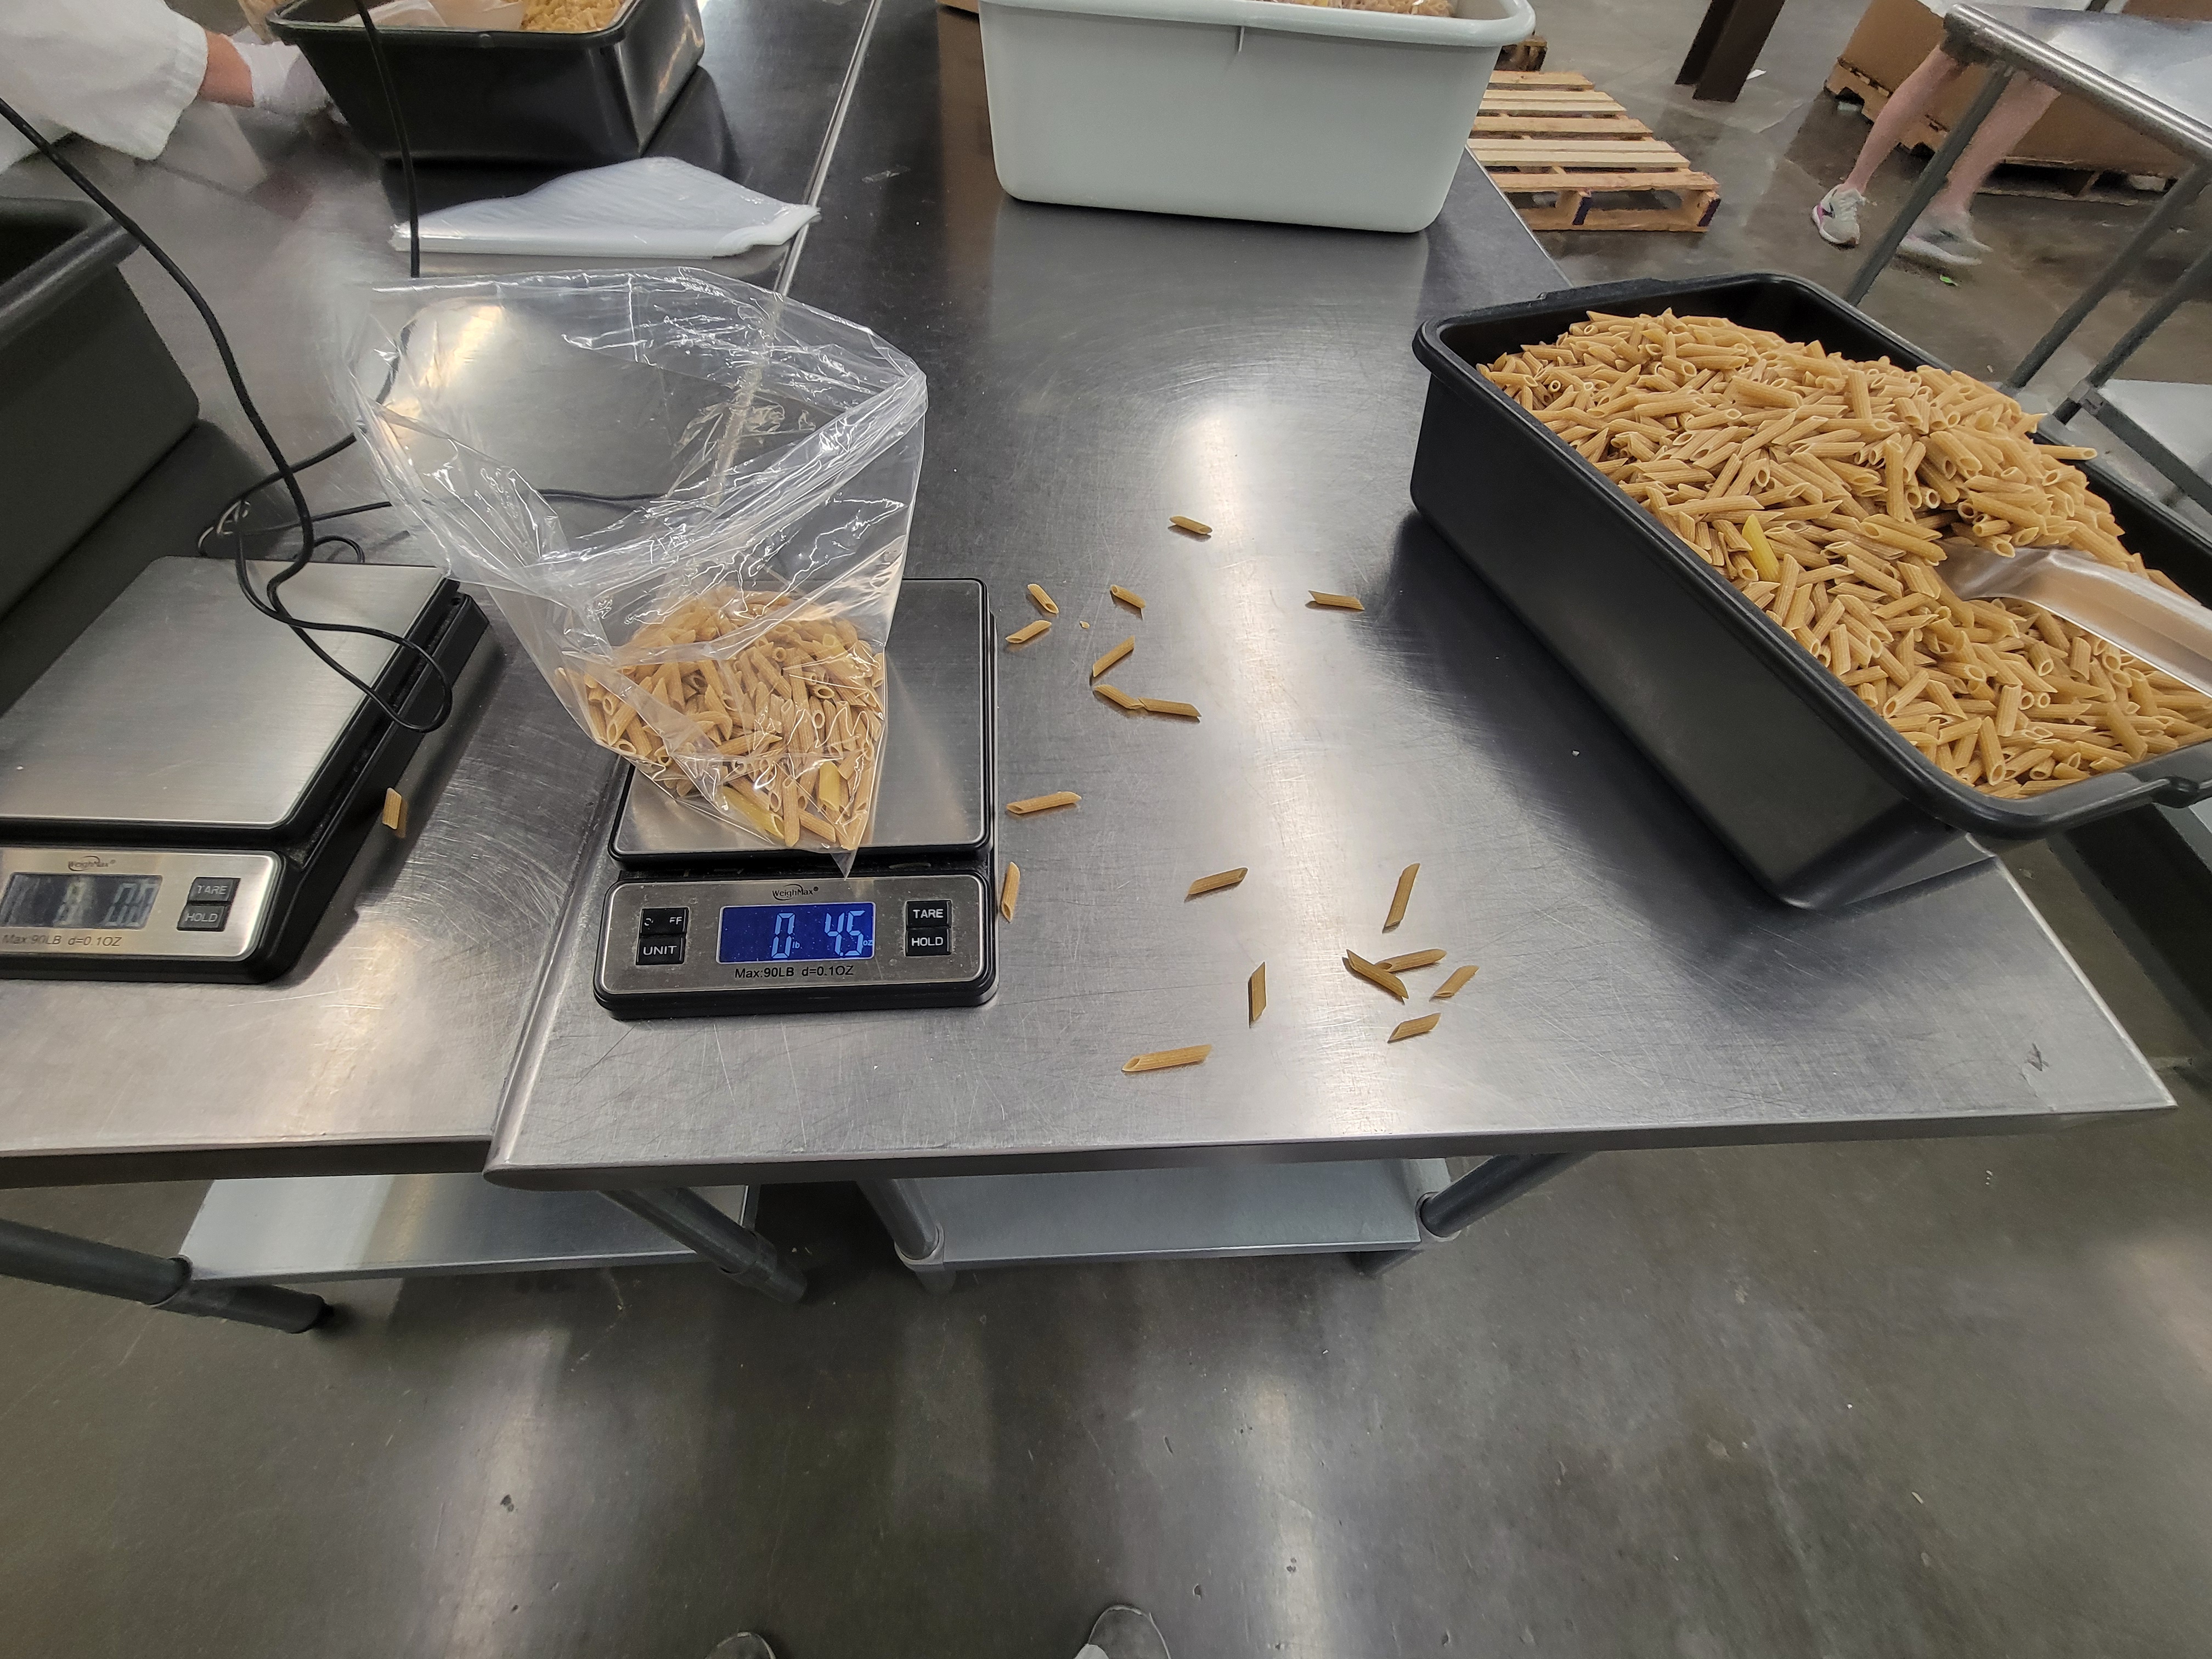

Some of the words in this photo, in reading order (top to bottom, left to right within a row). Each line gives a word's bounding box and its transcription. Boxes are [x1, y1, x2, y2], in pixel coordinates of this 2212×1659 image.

[198, 885, 228, 895] TARE
[185, 913, 218, 922] HOLD
[912, 909, 944, 919] TARE
[911, 936, 944, 946] HOLD
[643, 945, 677, 955] UNIT
[735, 967, 794, 978] Max:90LB
